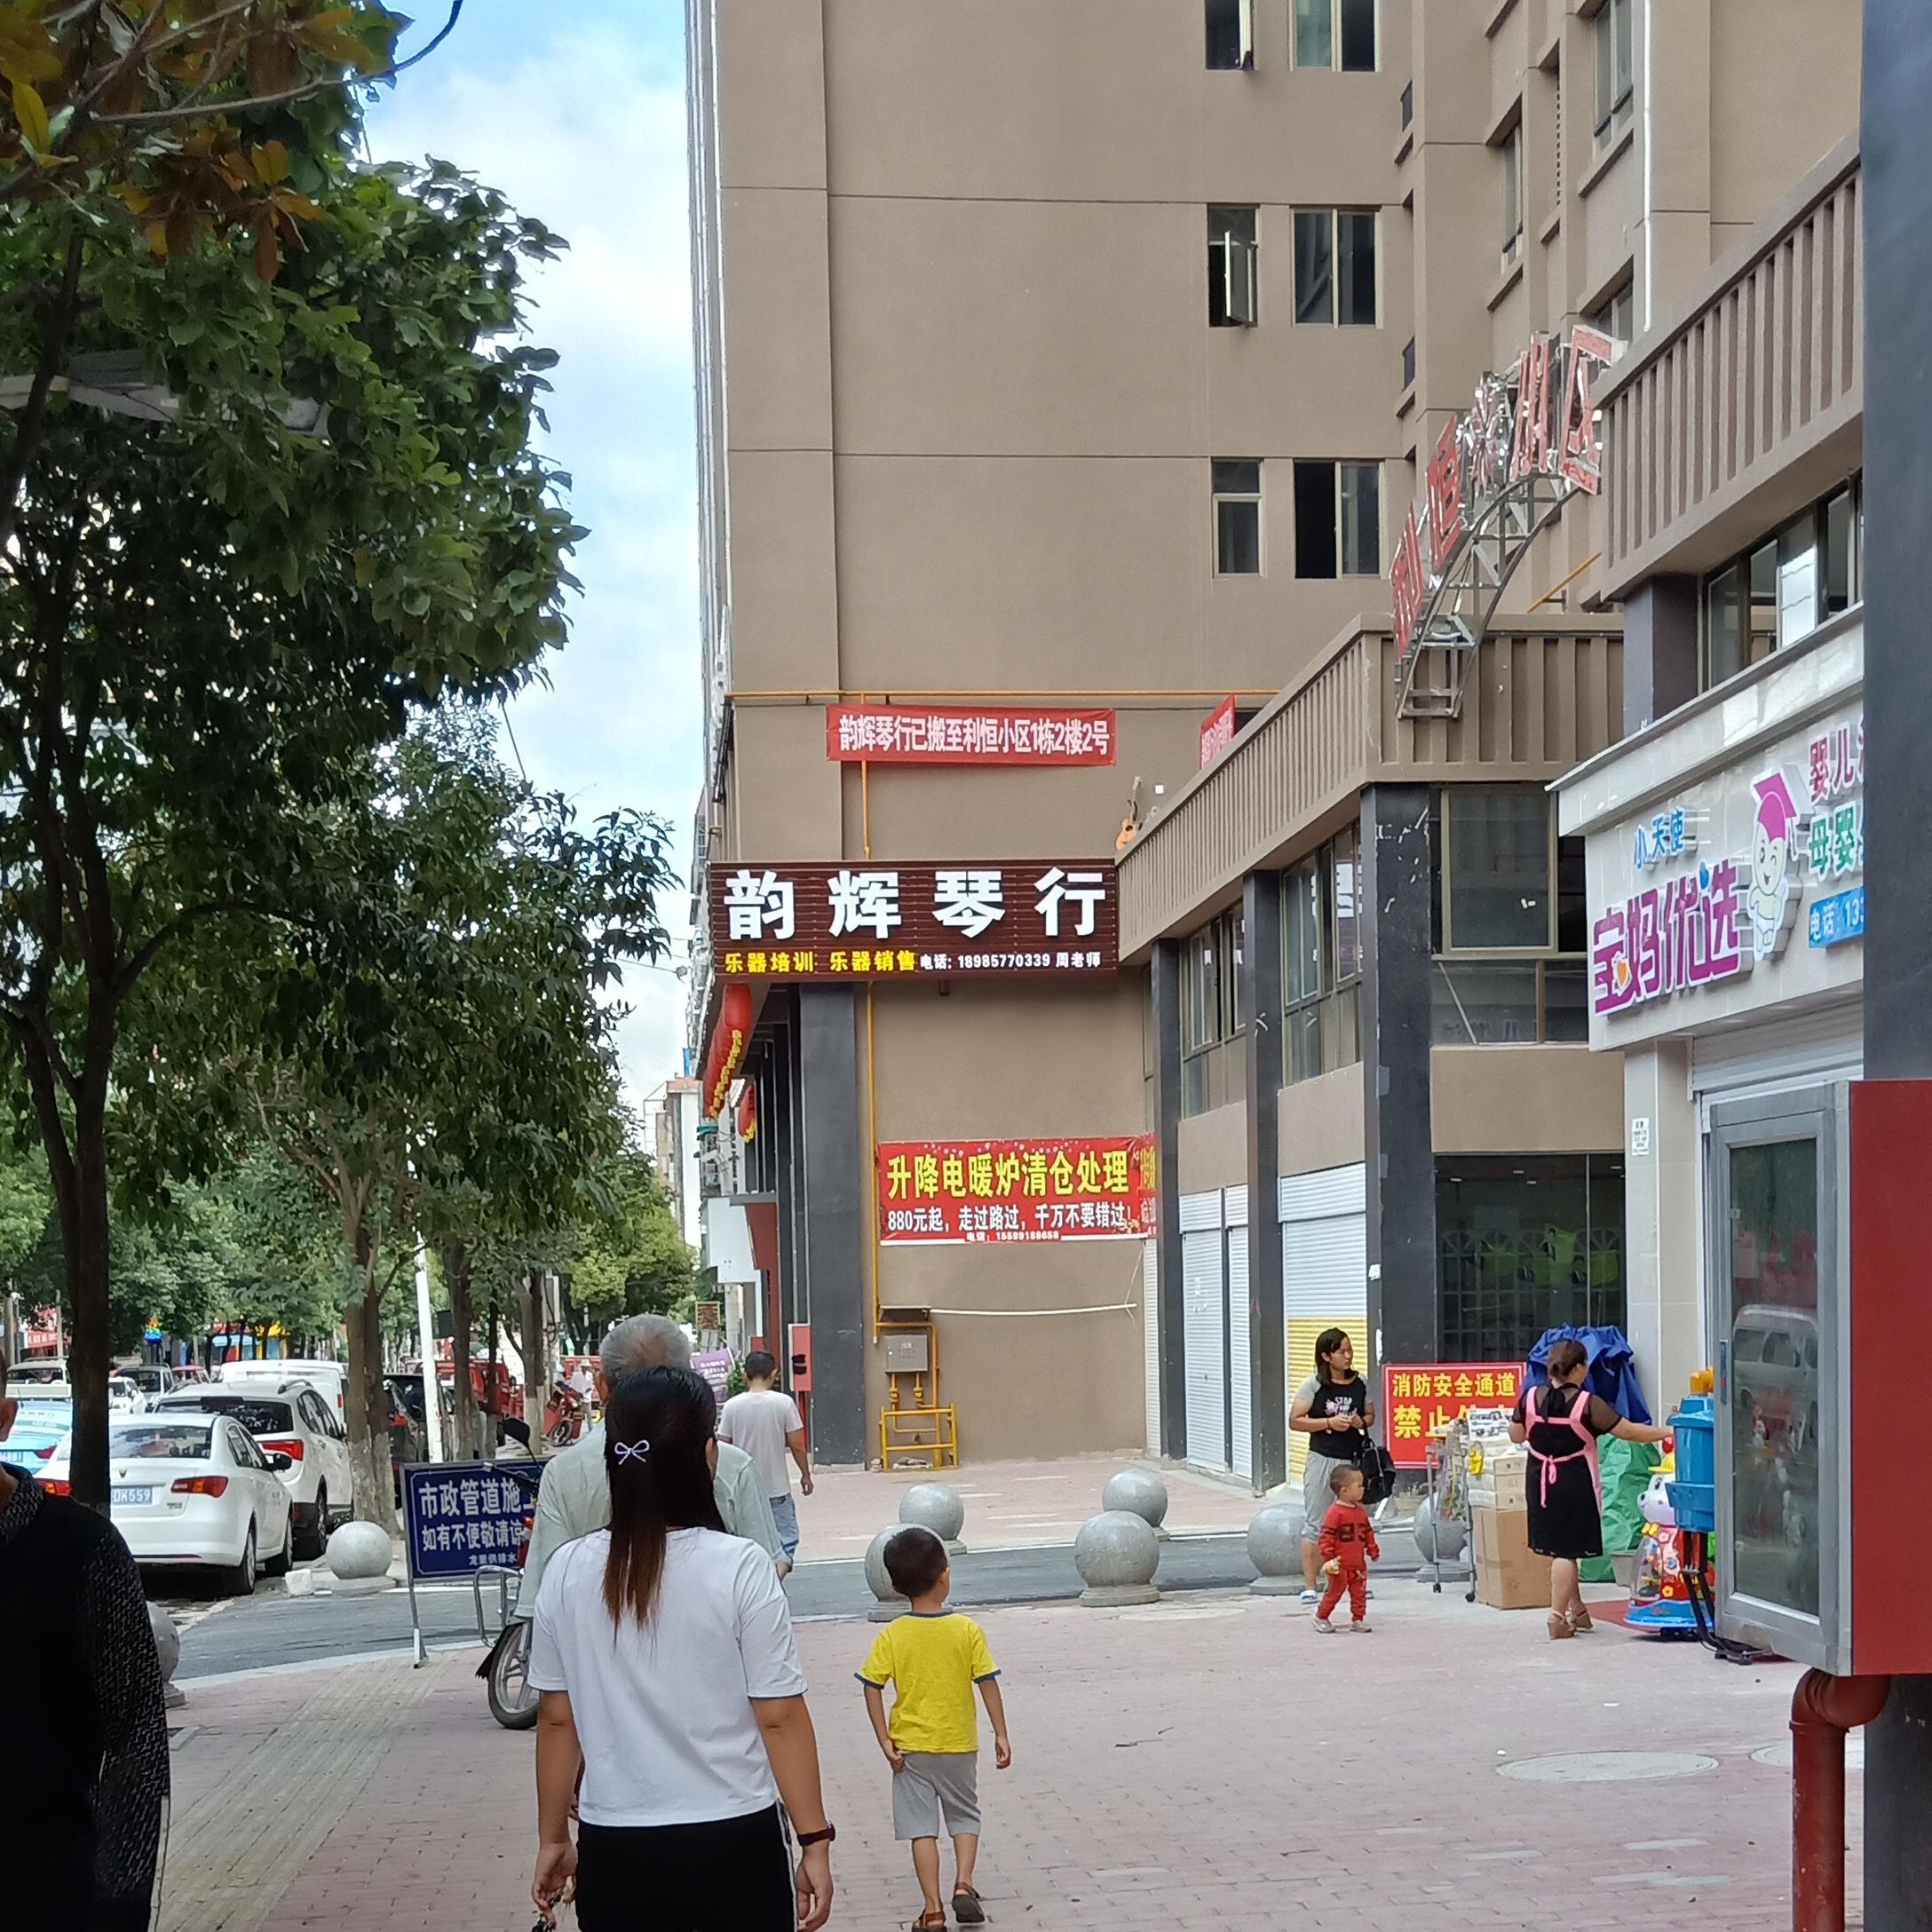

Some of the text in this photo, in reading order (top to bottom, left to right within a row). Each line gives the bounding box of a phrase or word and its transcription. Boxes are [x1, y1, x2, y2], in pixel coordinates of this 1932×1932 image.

[838, 714, 1110, 755] 韵辉琴行已搬至利恒小区1栋2楼2号
[1809, 726, 1864, 803] 婴儿
[1634, 809, 1684, 868] 小天使
[1809, 806, 1863, 875] 母婴
[724, 867, 1106, 940] 韵辉琴行
[724, 952, 814, 973] 乐器培训
[829, 949, 915, 972] 乐器销售
[958, 954, 1050, 969] 18985770339
[1056, 952, 1101, 968] 周老师
[1594, 858, 1739, 1013] 宝妈优选
[886, 1150, 1129, 1199] 升降电暖炉清仓处理
[1392, 1373, 1516, 1398] 消防安全通道
